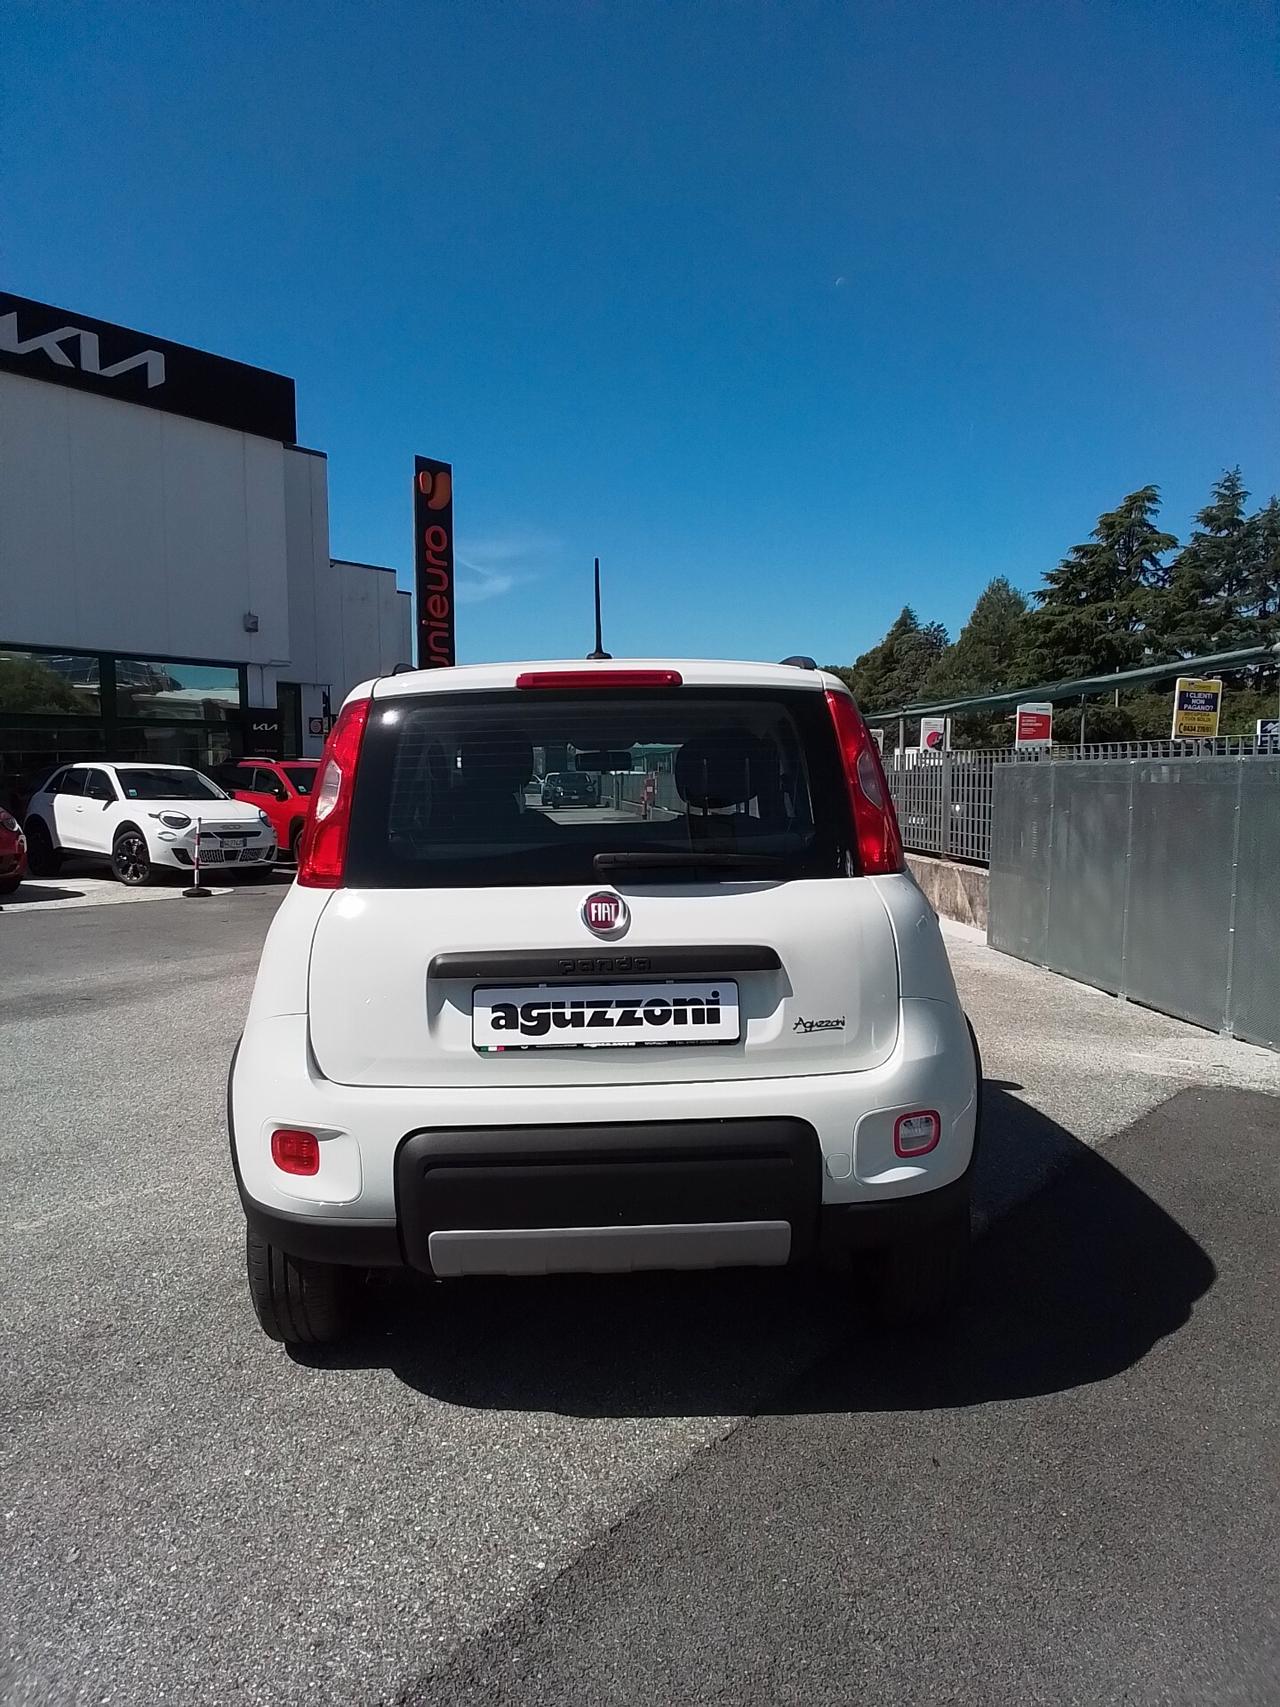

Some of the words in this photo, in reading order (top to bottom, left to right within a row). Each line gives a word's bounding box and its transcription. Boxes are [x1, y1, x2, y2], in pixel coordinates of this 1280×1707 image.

[0, 311, 165, 389] KIA
[591, 903, 617, 921] FIAT
[559, 956, 651, 976] panda
[490, 990, 721, 1036] aguzzoni
